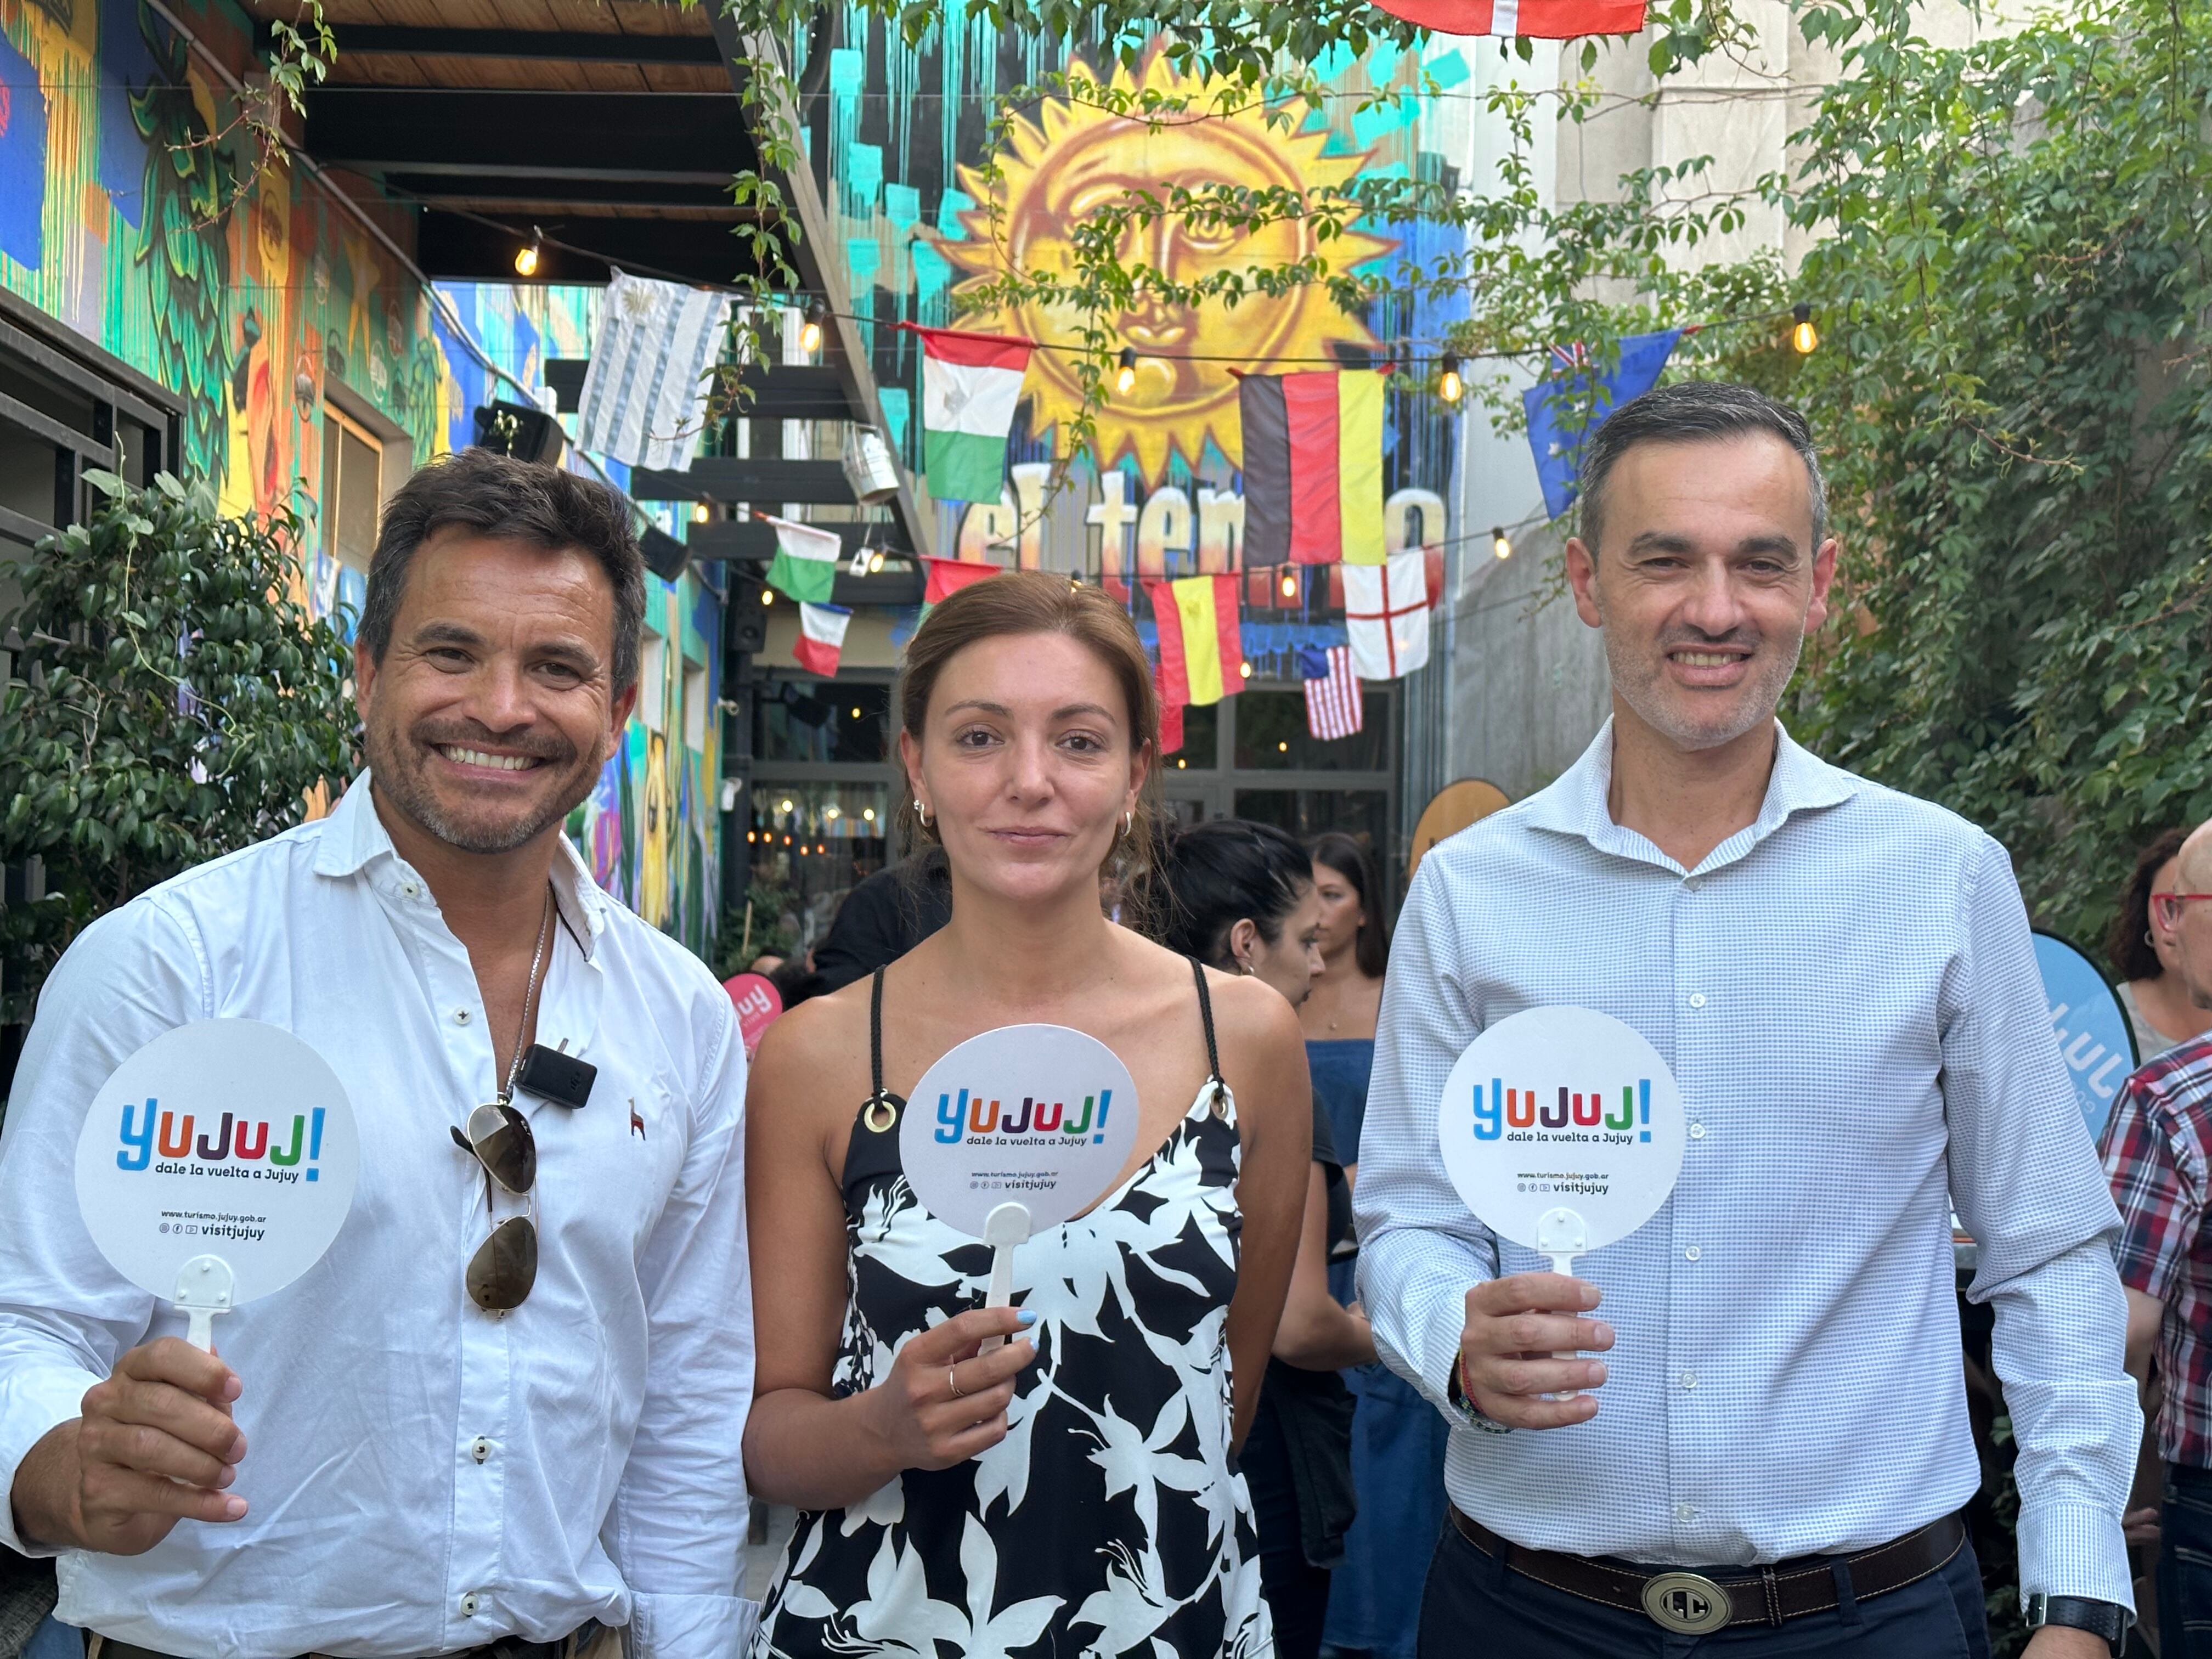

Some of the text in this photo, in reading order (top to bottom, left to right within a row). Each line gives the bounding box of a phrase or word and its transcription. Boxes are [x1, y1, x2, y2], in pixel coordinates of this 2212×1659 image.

[959, 462, 1051, 572] el
[967, 1136, 992, 1146] dale
[995, 1137, 1007, 1146] la
[1010, 1137, 1045, 1146] vuelta
[1058, 1136, 1087, 1147] Jujuy
[1507, 1131, 1533, 1142] dale
[1537, 1132, 1549, 1142] la
[1551, 1132, 1589, 1142] vuelta
[1602, 1132, 1633, 1146] Jujuy
[155, 1162, 299, 1184] dale la vuelta a Jujuy
[1517, 1172, 1609, 1181] www.turismo.jujuy.gob.ar
[1005, 1179, 1057, 1191] visitjujuy
[1553, 1182, 1609, 1195] visitjujuy
[161, 1211, 267, 1224] www.turismo.jujuy.gob.ar
[202, 1223, 266, 1241] visitjujuy
